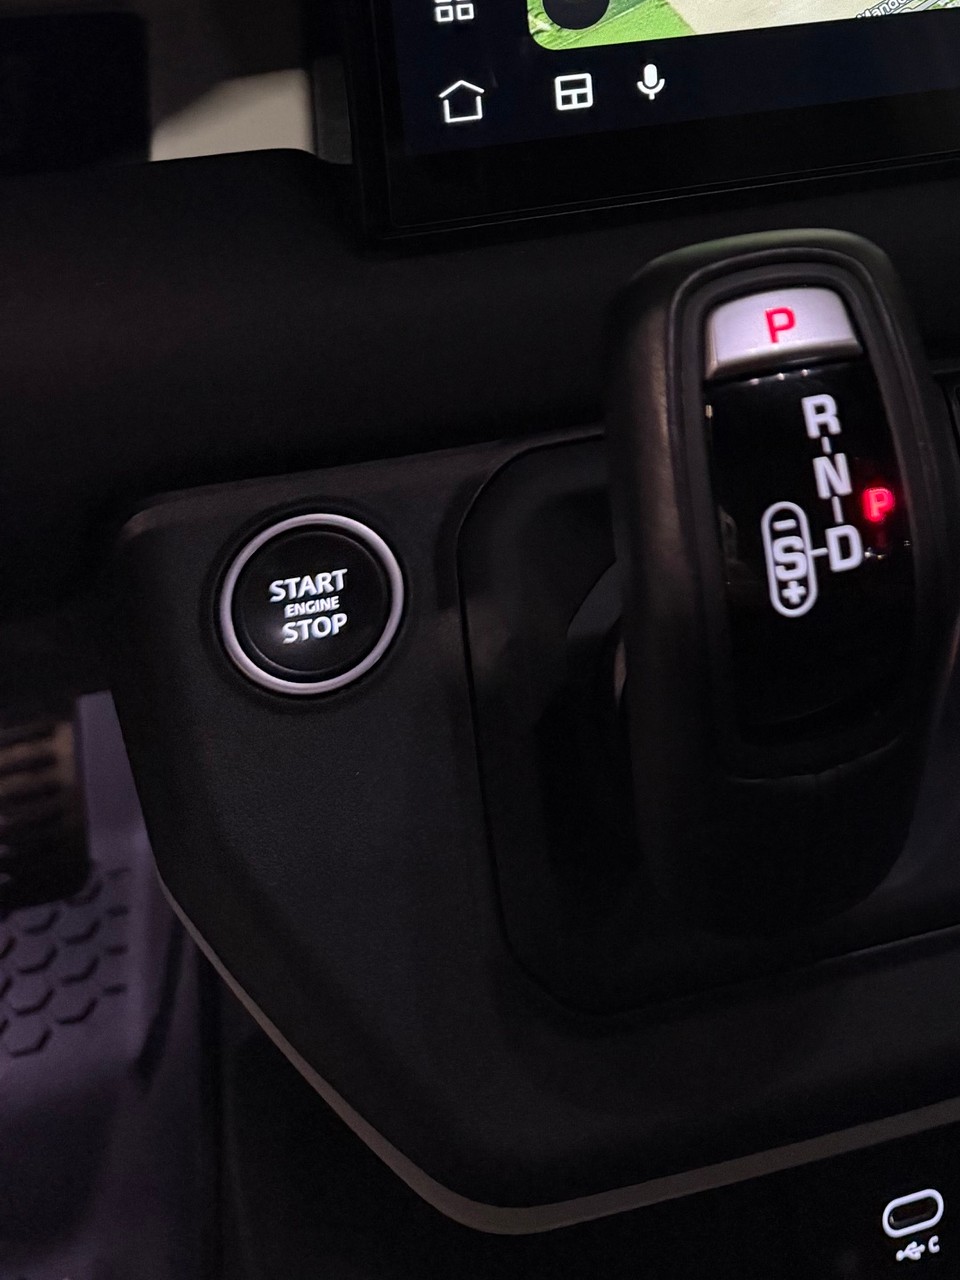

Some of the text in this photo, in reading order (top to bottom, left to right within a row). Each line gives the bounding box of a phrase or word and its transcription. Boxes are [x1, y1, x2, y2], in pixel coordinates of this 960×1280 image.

[764, 305, 797, 344] P
[801, 392, 842, 440] R
[812, 452, 853, 500] N
[862, 485, 896, 523] P
[772, 534, 809, 582] S
[825, 524, 864, 573] D
[268, 568, 349, 603] START
[283, 595, 340, 619] ENGINE
[281, 612, 348, 644] STOP
